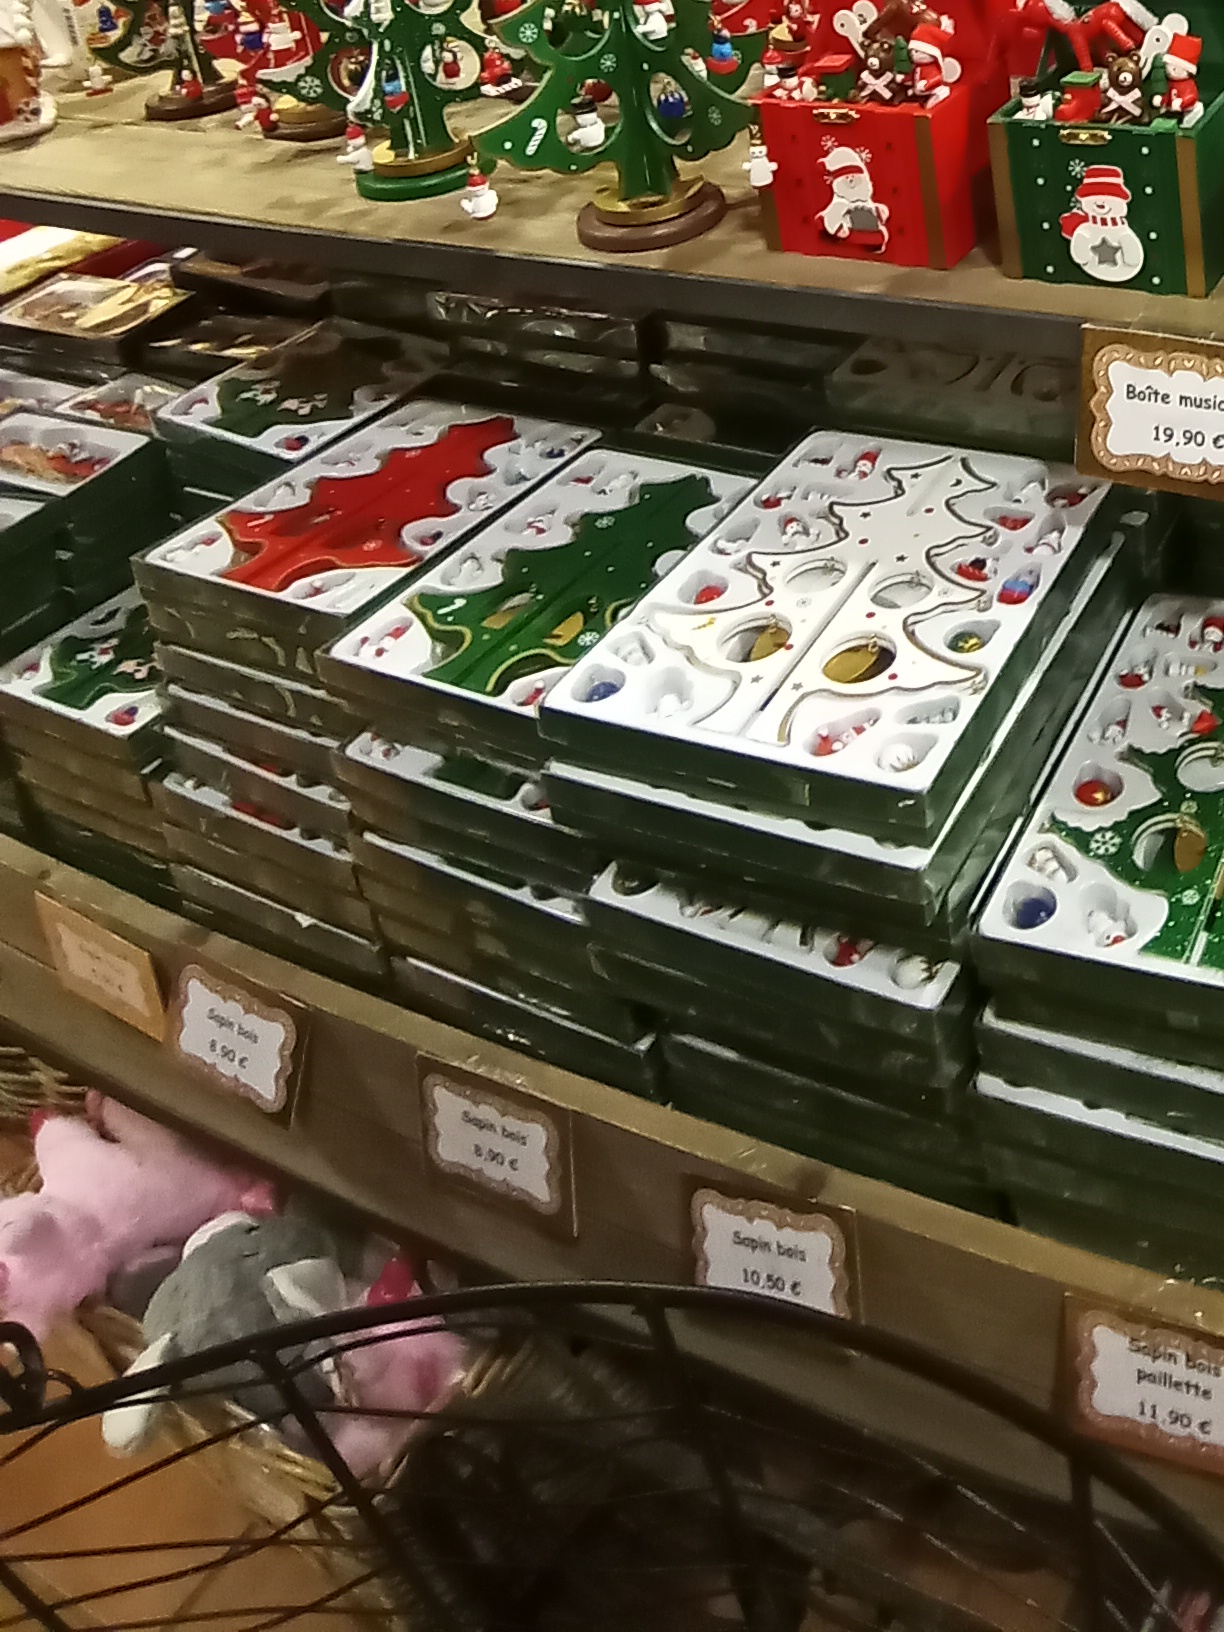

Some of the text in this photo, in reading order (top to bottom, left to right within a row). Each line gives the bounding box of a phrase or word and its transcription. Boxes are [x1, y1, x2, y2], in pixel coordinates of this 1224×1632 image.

[1126, 383, 1171, 405] Boîte
[1152, 424, 1206, 448] 19,90
[207, 1007, 259, 1044] Sapin bois
[238, 1056, 249, 1069] €
[461, 1109, 528, 1147] Sapin bois
[508, 1158, 519, 1171] €
[732, 1230, 807, 1263] Sapin bois
[742, 1268, 802, 1296] 10,50 €
[1128, 1337, 1223, 1378] Sapin bois
[1136, 1368, 1213, 1401] paillette
[1199, 1420, 1213, 1436] €
